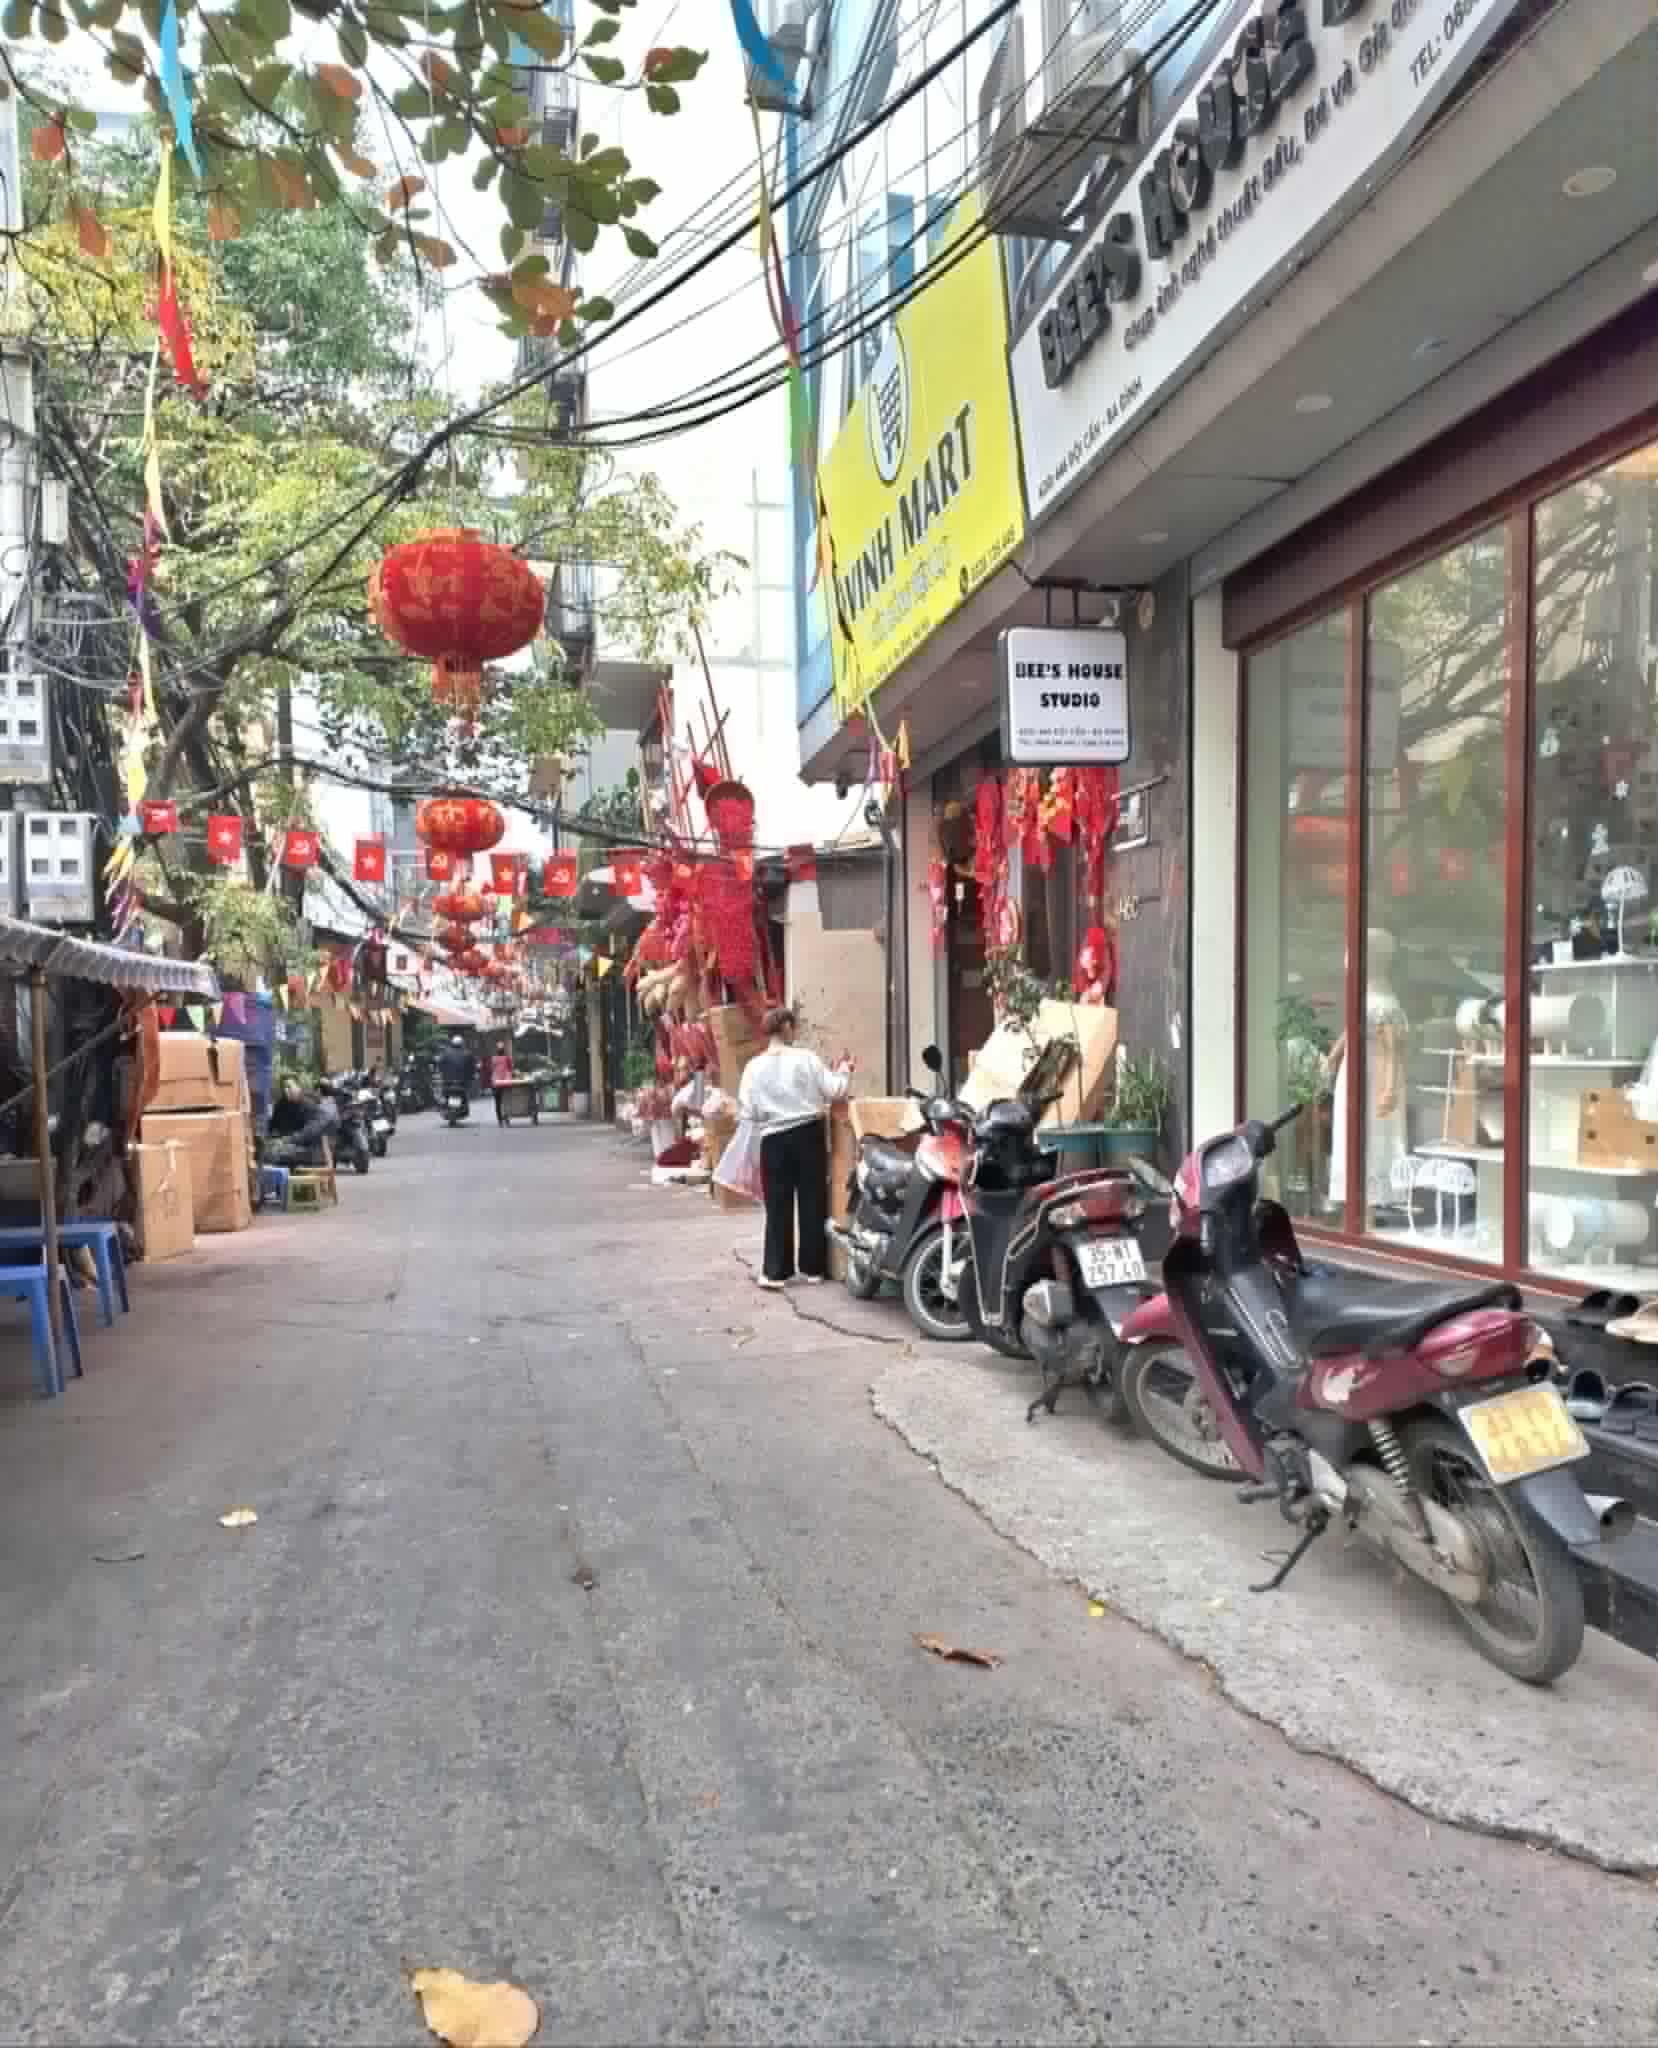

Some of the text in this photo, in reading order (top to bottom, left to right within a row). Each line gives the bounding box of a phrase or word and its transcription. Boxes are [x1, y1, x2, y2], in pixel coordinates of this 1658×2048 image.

[1137, 4, 1316, 261] HOUSE
[898, 402, 971, 557] MART
[1015, 662, 1123, 680] BEE'S HOUSE
[1039, 691, 1102, 709] STUDIO
